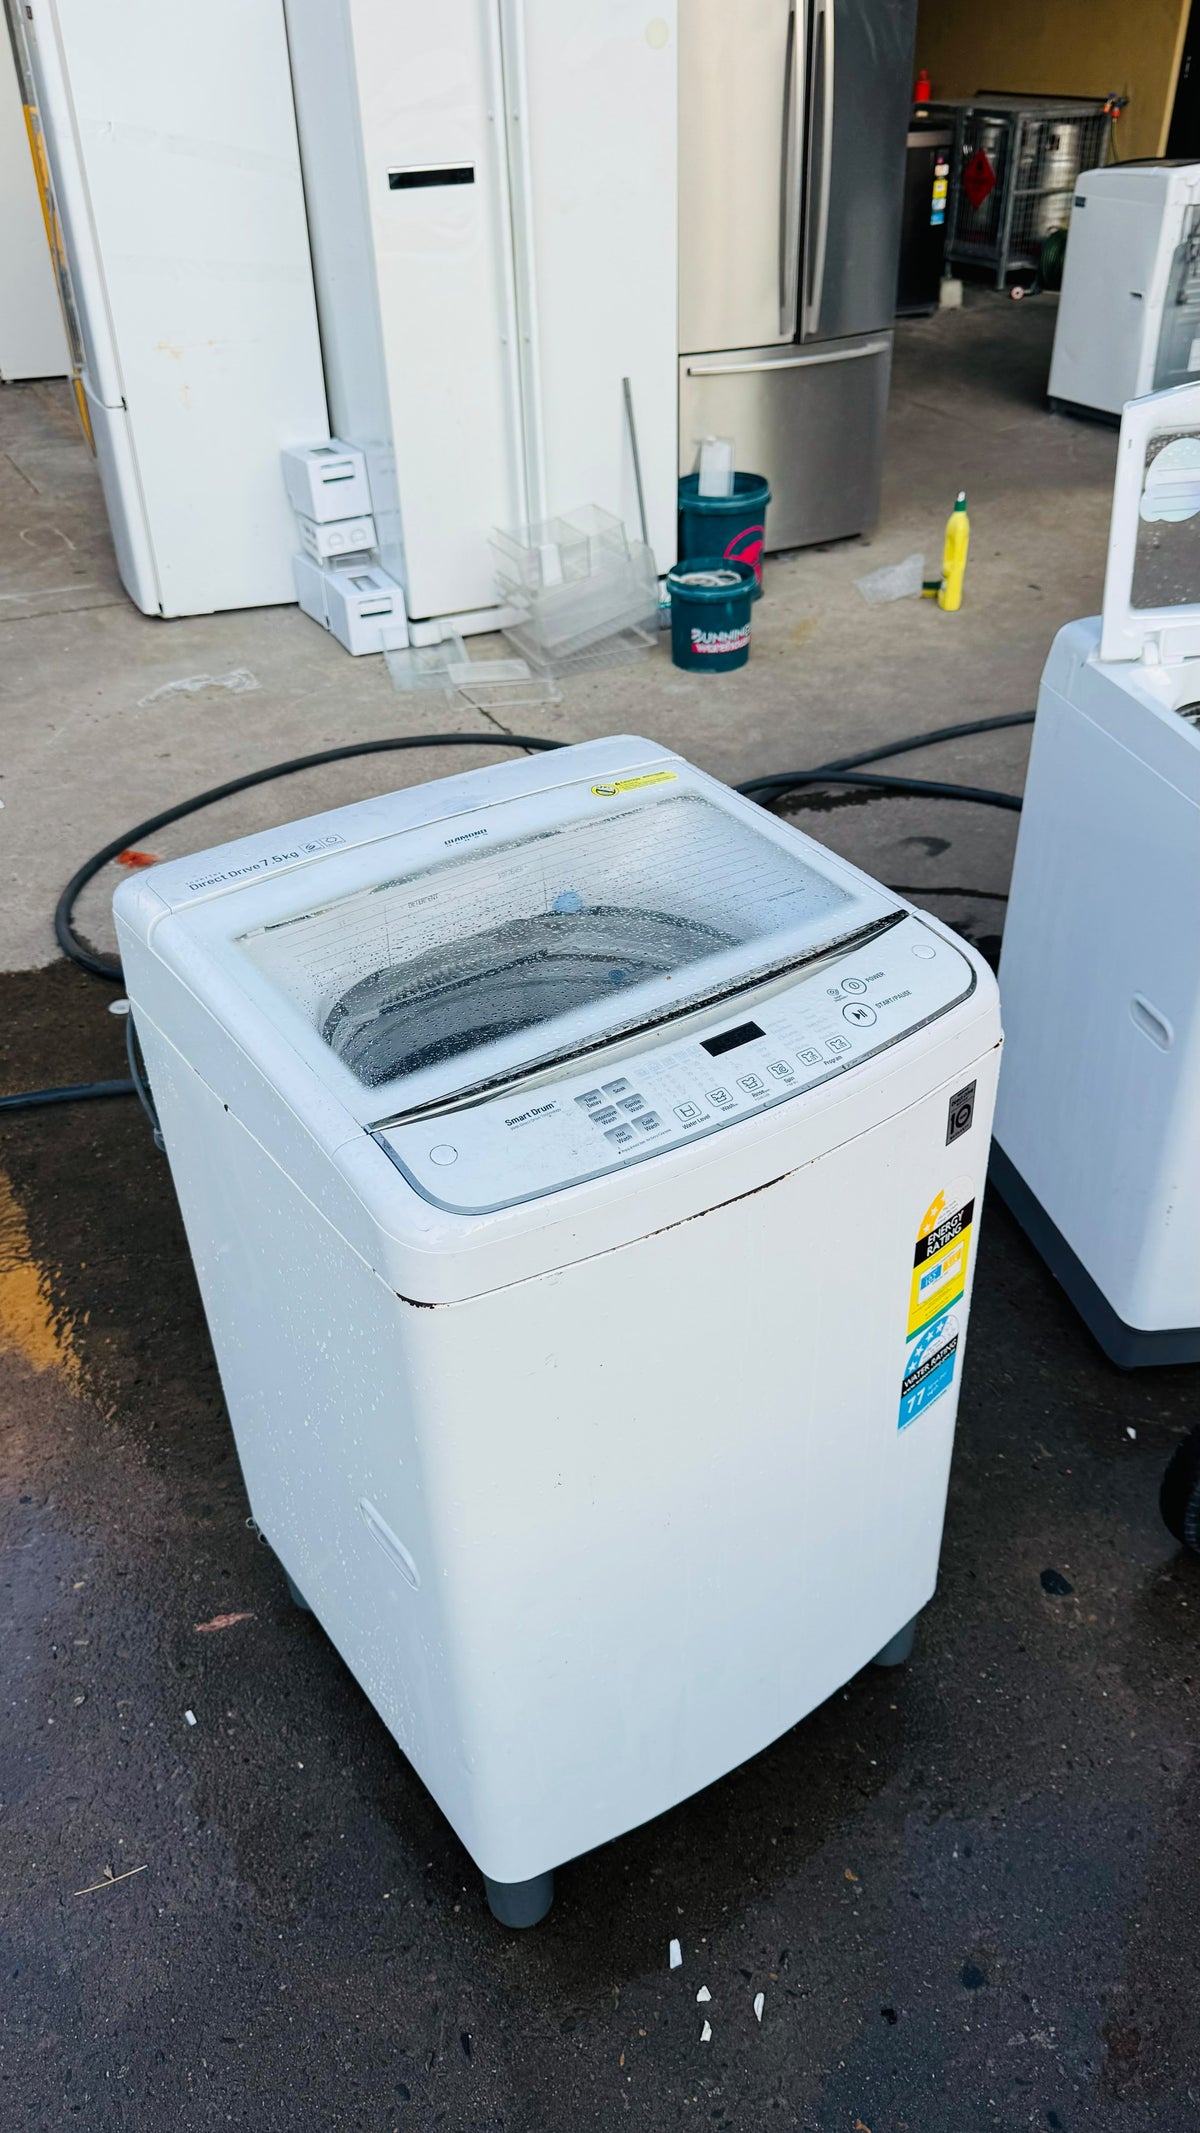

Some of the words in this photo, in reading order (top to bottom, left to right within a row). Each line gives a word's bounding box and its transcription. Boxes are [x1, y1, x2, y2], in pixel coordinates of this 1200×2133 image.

[444, 828, 487, 845] DIAMOND
[189, 874, 227, 891] Direct
[228, 863, 261, 878] Drive
[865, 971, 886, 983] POWER
[875, 990, 912, 1009] START/PAUSE
[824, 1055, 843, 1066] Program
[624, 1099, 642, 1109] Gentle
[629, 1104, 645, 1113] Wash
[721, 1103, 735, 1112] Wash
[504, 1112, 532, 1127] Smart
[594, 1110, 618, 1122] Intensive
[601, 1116, 618, 1126] Wash
[642, 1117, 655, 1126] Cold
[682, 1119, 698, 1130] Water
[697, 1113, 711, 1123] Level
[951, 1104, 972, 1135] 10
[644, 1122, 660, 1132] Wash
[615, 1130, 626, 1139] Hot
[617, 1134, 633, 1144] Wash
[927, 1209, 964, 1246] ENERGY
[926, 1222, 962, 1257] RATING
[904, 1363, 930, 1388] WATER
[930, 1338, 957, 1366] RATING
[907, 1386, 926, 1414] 77
